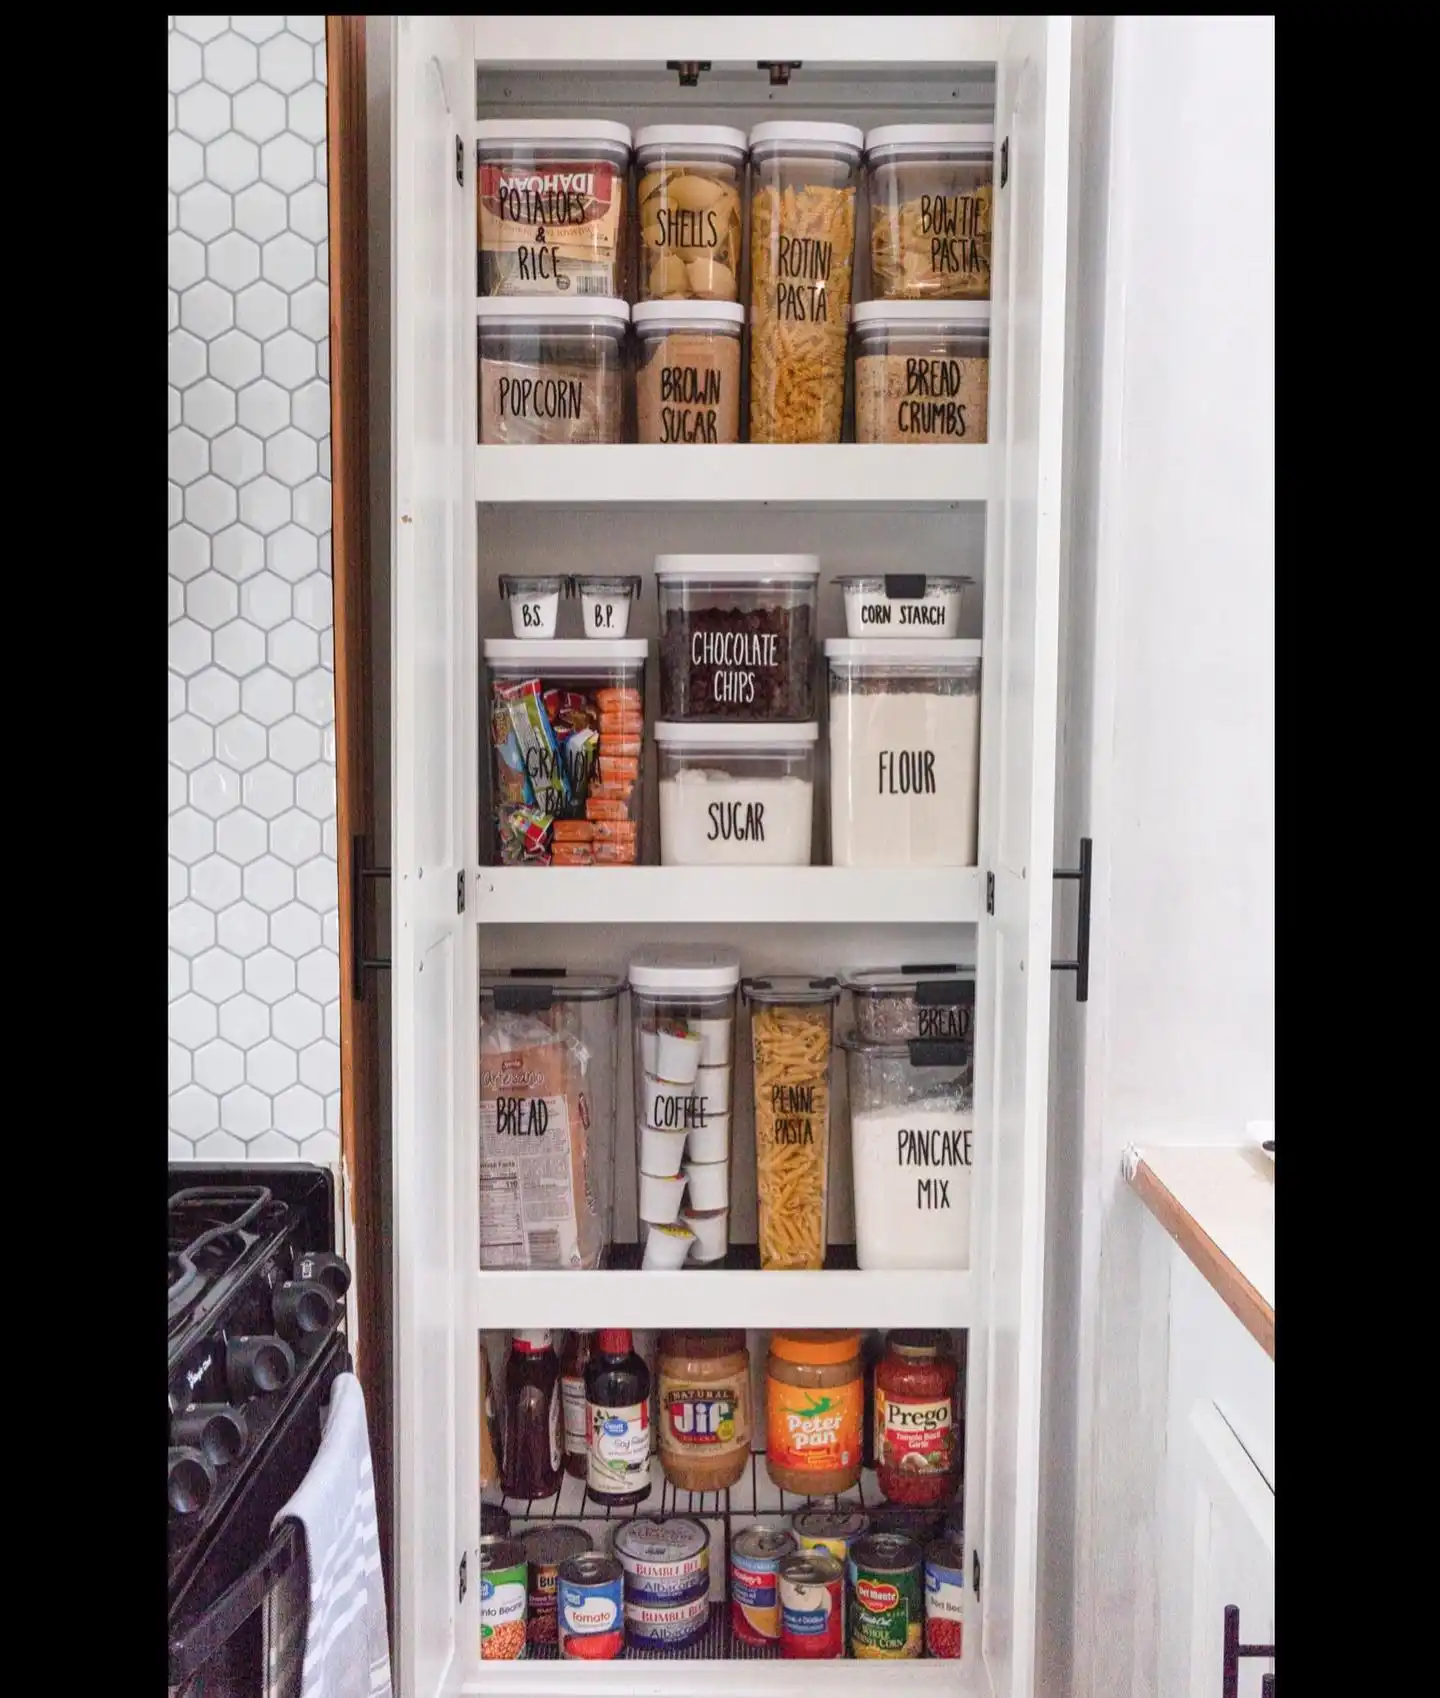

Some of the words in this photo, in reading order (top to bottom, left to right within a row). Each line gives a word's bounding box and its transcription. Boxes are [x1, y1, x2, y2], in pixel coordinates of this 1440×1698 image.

[498, 186, 586, 225] POTATOES
[921, 194, 986, 236] BOWTIE
[535, 226, 546, 244] &
[655, 209, 718, 249] SHELLS
[517, 246, 562, 281] RICE
[778, 235, 832, 280] ROTINI
[931, 237, 981, 273] PASTA
[777, 282, 828, 322] PASTA
[660, 367, 721, 405] BROWN
[906, 358, 961, 397] BREAD
[499, 376, 583, 419] POPCORN
[659, 407, 718, 444] SUGAR
[898, 401, 966, 437] CRUMBS
[522, 604, 544, 627] B.S.
[594, 604, 615, 628] B.P.
[861, 605, 892, 624] CORN
[899, 605, 946, 625] STARCH
[692, 631, 779, 666] CHOCOLATE
[714, 670, 755, 703] CHIPS
[878, 750, 937, 795] FLOUR
[707, 801, 765, 842] SUGAR
[917, 1008, 970, 1037] BREAD
[496, 1096, 549, 1137] BREAD
[653, 1094, 708, 1129] COFFEE
[771, 1085, 815, 1113] PENNE
[774, 1118, 814, 1145] PASTA
[897, 1129, 973, 1167] PANCAKE
[917, 1178, 951, 1210] MIX
[787, 1414, 843, 1433] Peter
[888, 1404, 948, 1430] Prego
[572, 1611, 611, 1625] Tomato
